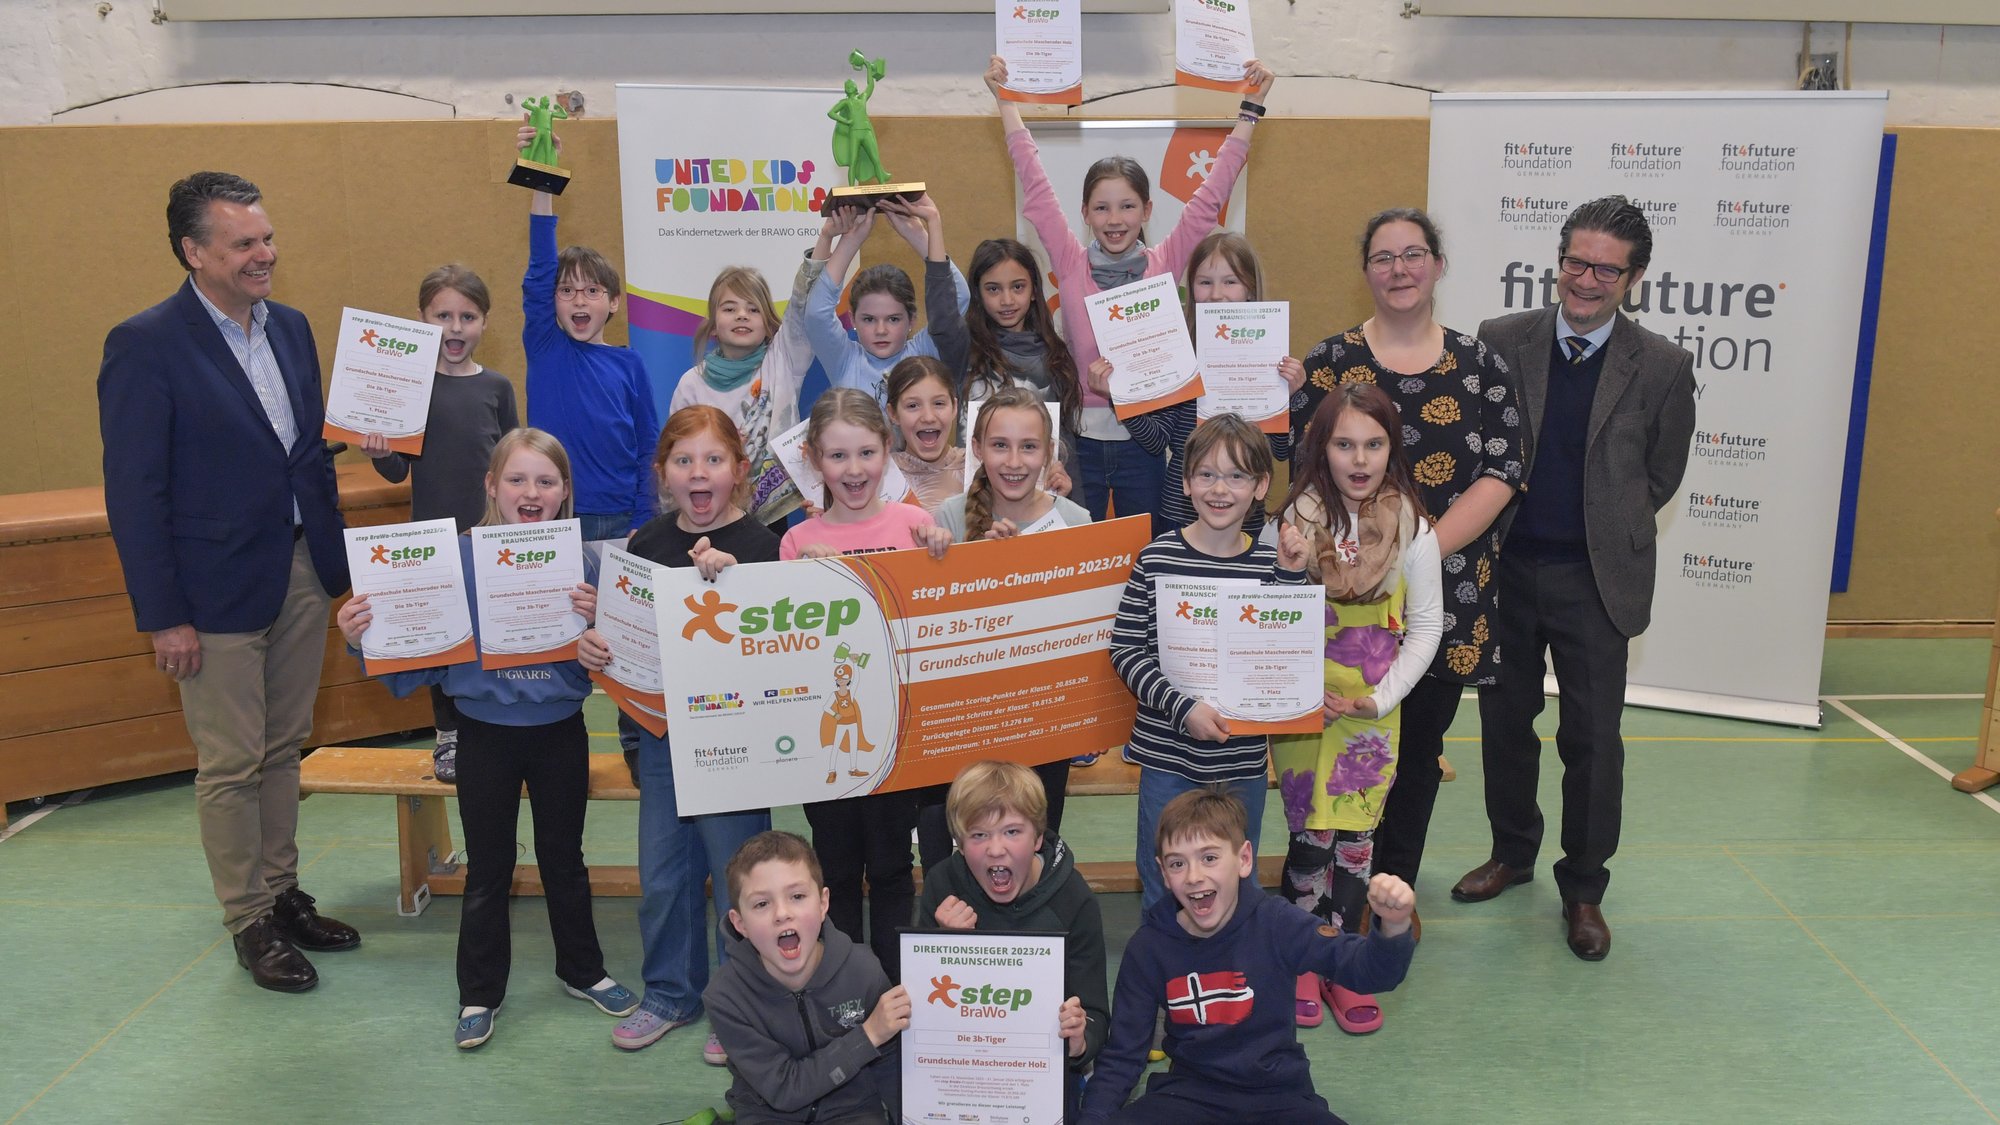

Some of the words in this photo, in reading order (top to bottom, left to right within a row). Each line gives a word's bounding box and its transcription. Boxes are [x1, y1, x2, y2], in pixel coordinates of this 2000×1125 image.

[1206, 0, 1235, 12] step
[1028, 9, 1059, 20] step
[1504, 143, 1572, 156] fit4future
[1611, 143, 1682, 157] fit4future
[1722, 143, 1795, 157] fit4future
[752, 159, 815, 185] KIDS
[1501, 196, 1568, 211] fit4future
[1631, 198, 1677, 212] future
[1716, 200, 1790, 214] fit4future
[658, 228, 675, 237] Das
[676, 227, 743, 237] Kindernetzwerk
[745, 228, 759, 237] der
[761, 228, 795, 237] BRAWO
[797, 228, 820, 237] GRO
[1124, 298, 1160, 316] step
[1126, 312, 1150, 323] BraWo
[365, 318, 411, 332] BraWo-Champion
[1231, 327, 1266, 340] step
[376, 347, 403, 358] BraWo
[377, 337, 418, 355] step
[1695, 431, 1766, 447] fit4future
[1690, 493, 1760, 509] fit4future
[1702, 521, 1742, 529] GERMANY
[370, 530, 422, 541] BraWo-Champion
[482, 528, 545, 539] DIREKTIONSSIEGER
[501, 535, 555, 545] BRAUNSCHWEIG
[391, 546, 436, 561] step
[516, 549, 557, 563] step
[392, 560, 422, 569] BraWo
[610, 552, 652, 574] DIREKTIONSSIE
[1683, 553, 1753, 571] fit4future
[911, 583, 945, 600] step
[950, 565, 1075, 595] BraWo-Champion
[1077, 553, 1132, 573] 2023/24
[631, 586, 655, 602] ste
[630, 595, 654, 609] BraWo
[739, 596, 861, 637] step
[1193, 606, 1217, 618] ste
[1259, 608, 1302, 624] step
[917, 622, 943, 638] Die
[948, 612, 1014, 635] 3b-Tiger
[740, 632, 820, 656] BraWo
[919, 649, 1006, 672] Grundschule
[1009, 634, 1093, 658] Mascheroder
[1096, 629, 1112, 642] Ho
[718, 692, 739, 702] KIDS
[766, 697, 792, 705] HELFEN
[793, 694, 822, 702] KINDERN
[920, 702, 964, 712] Gesammelte
[965, 691, 1016, 706] Scoring-Punkte
[1017, 688, 1029, 696] der
[1030, 685, 1053, 693] Klasse:
[921, 715, 965, 727] Gesammelte
[966, 708, 993, 720] Schritte
[994, 705, 1005, 714] der
[1007, 701, 1030, 712] Klasse:
[922, 728, 971, 742] Zurückgelegte
[972, 723, 999, 733] Distanz:
[1001, 718, 1022, 728] 13.276
[923, 741, 981, 756] Projektzeitraum:
[982, 738, 991, 746] 13.
[993, 732, 1028, 744] November
[1028, 727, 1044, 737] 2023
[1050, 725, 1059, 733] 31.
[1059, 721, 1082, 732] Januar
[1082, 716, 1098, 726] 2024
[694, 746, 748, 758] fit4future
[913, 945, 1008, 955] DIREKTIONSSIEGER
[1011, 947, 1051, 956] 2023/24
[940, 957, 1023, 966] BRAUNSCHWEIG
[960, 984, 1032, 1011] step
[960, 1006, 1007, 1018] BraWo
[957, 1034, 971, 1042] Die
[972, 1035, 1006, 1045] 3b-Tiger
[917, 1056, 970, 1066] Grundschule
[972, 1058, 1026, 1068] Mascheroder
[1028, 1060, 1047, 1068] Holz
